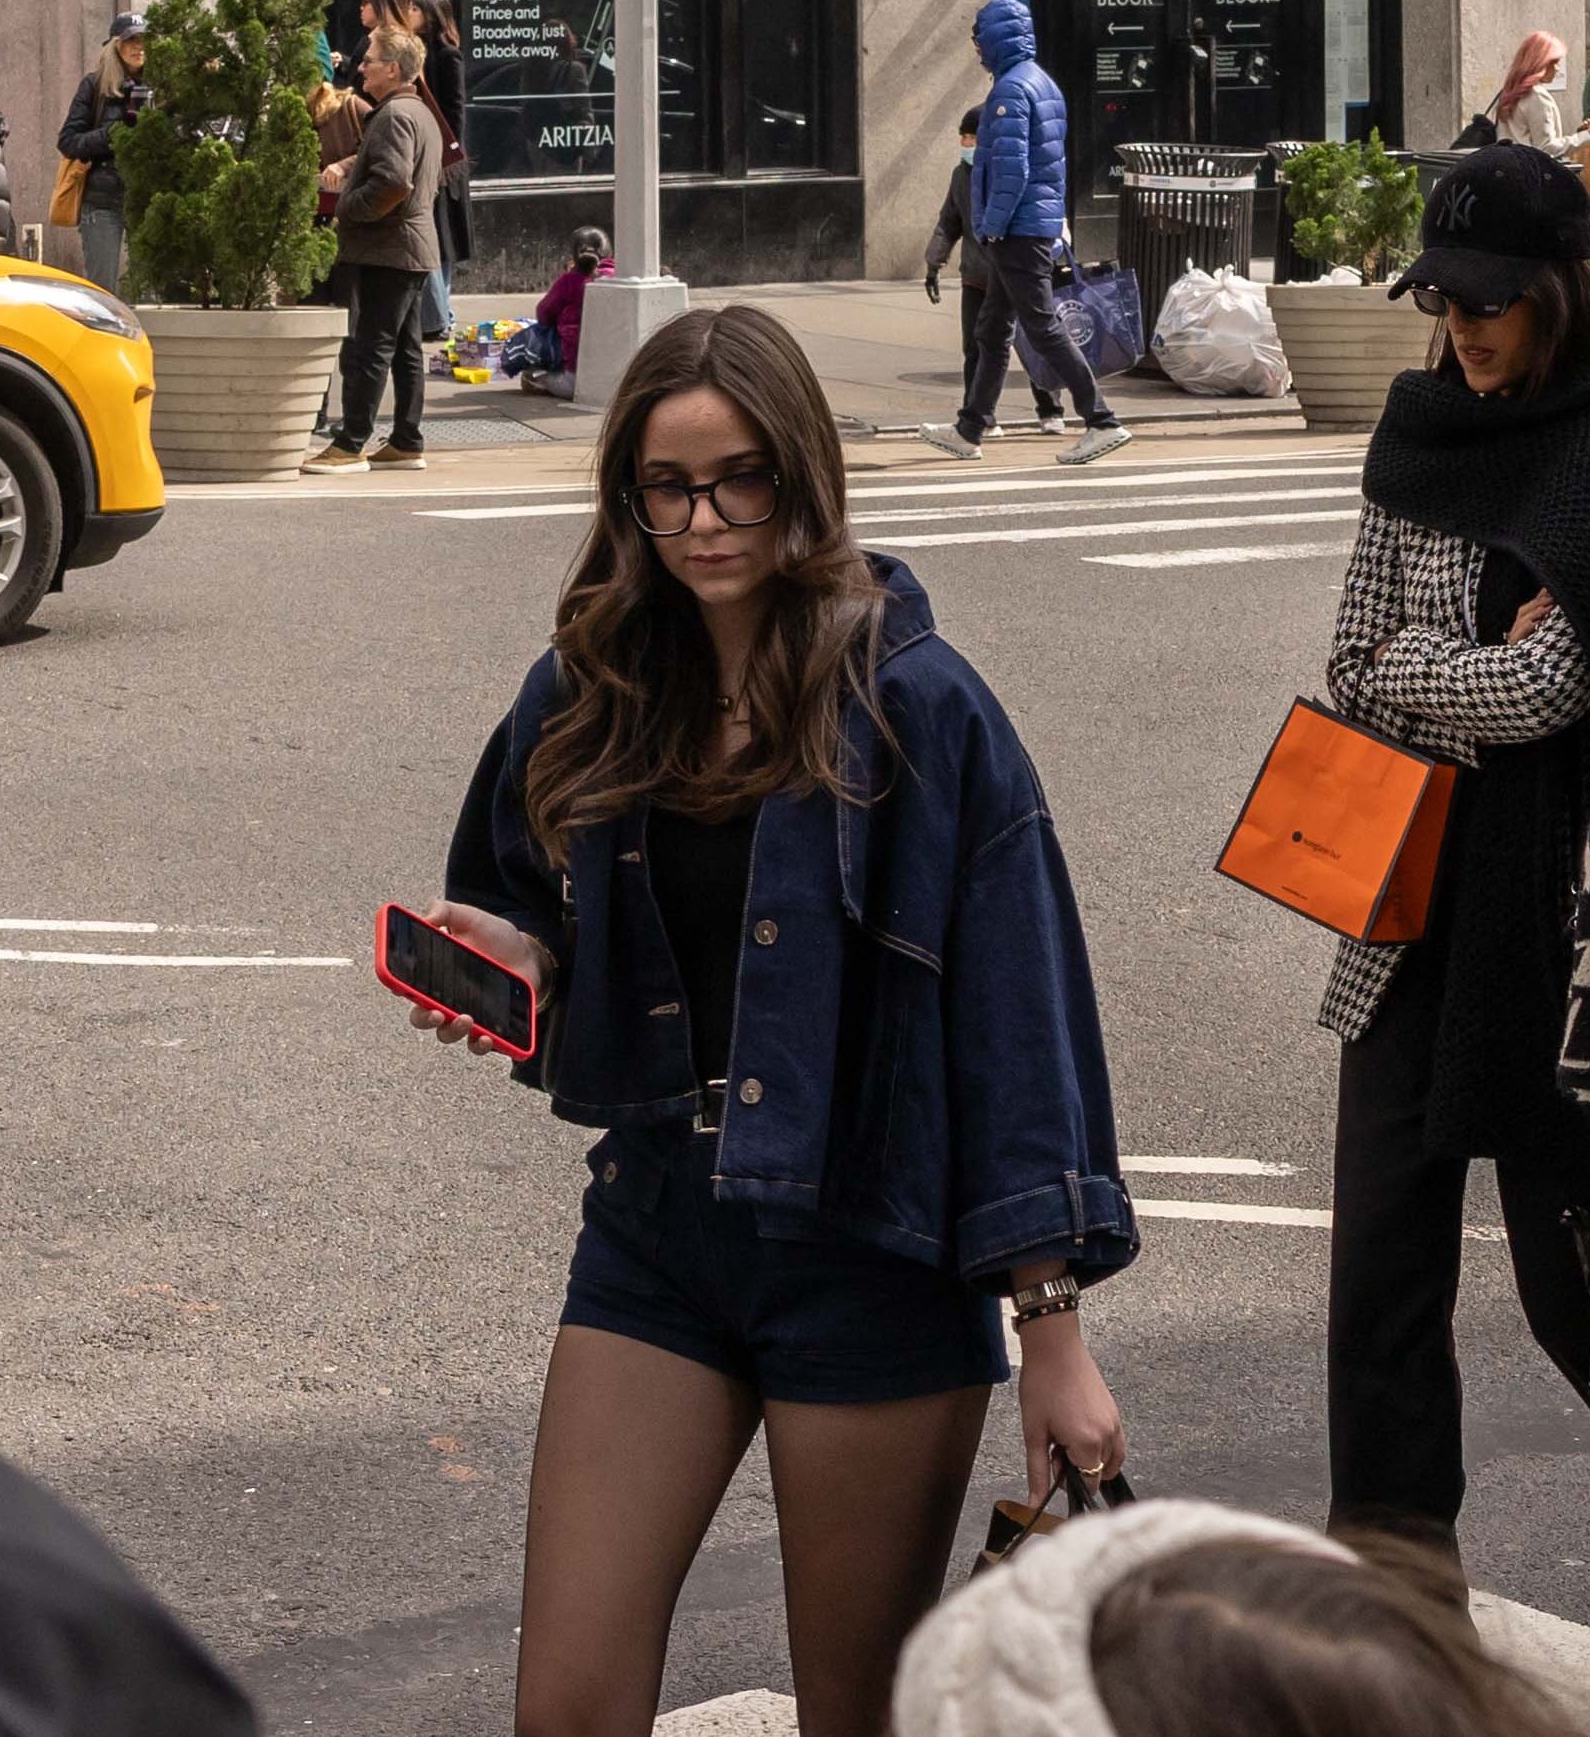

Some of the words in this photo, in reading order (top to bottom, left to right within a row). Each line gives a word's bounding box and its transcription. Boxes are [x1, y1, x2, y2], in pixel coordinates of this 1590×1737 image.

[472, 6, 512, 20] Prince
[515, 5, 540, 20] and
[472, 25, 541, 41] Broadway,
[542, 23, 565, 40] just
[472, 47, 482, 58] a
[484, 45, 519, 58] block
[521, 46, 559, 59] away.
[538, 125, 615, 148] ARITZIA
[1436, 182, 1479, 231] NY
